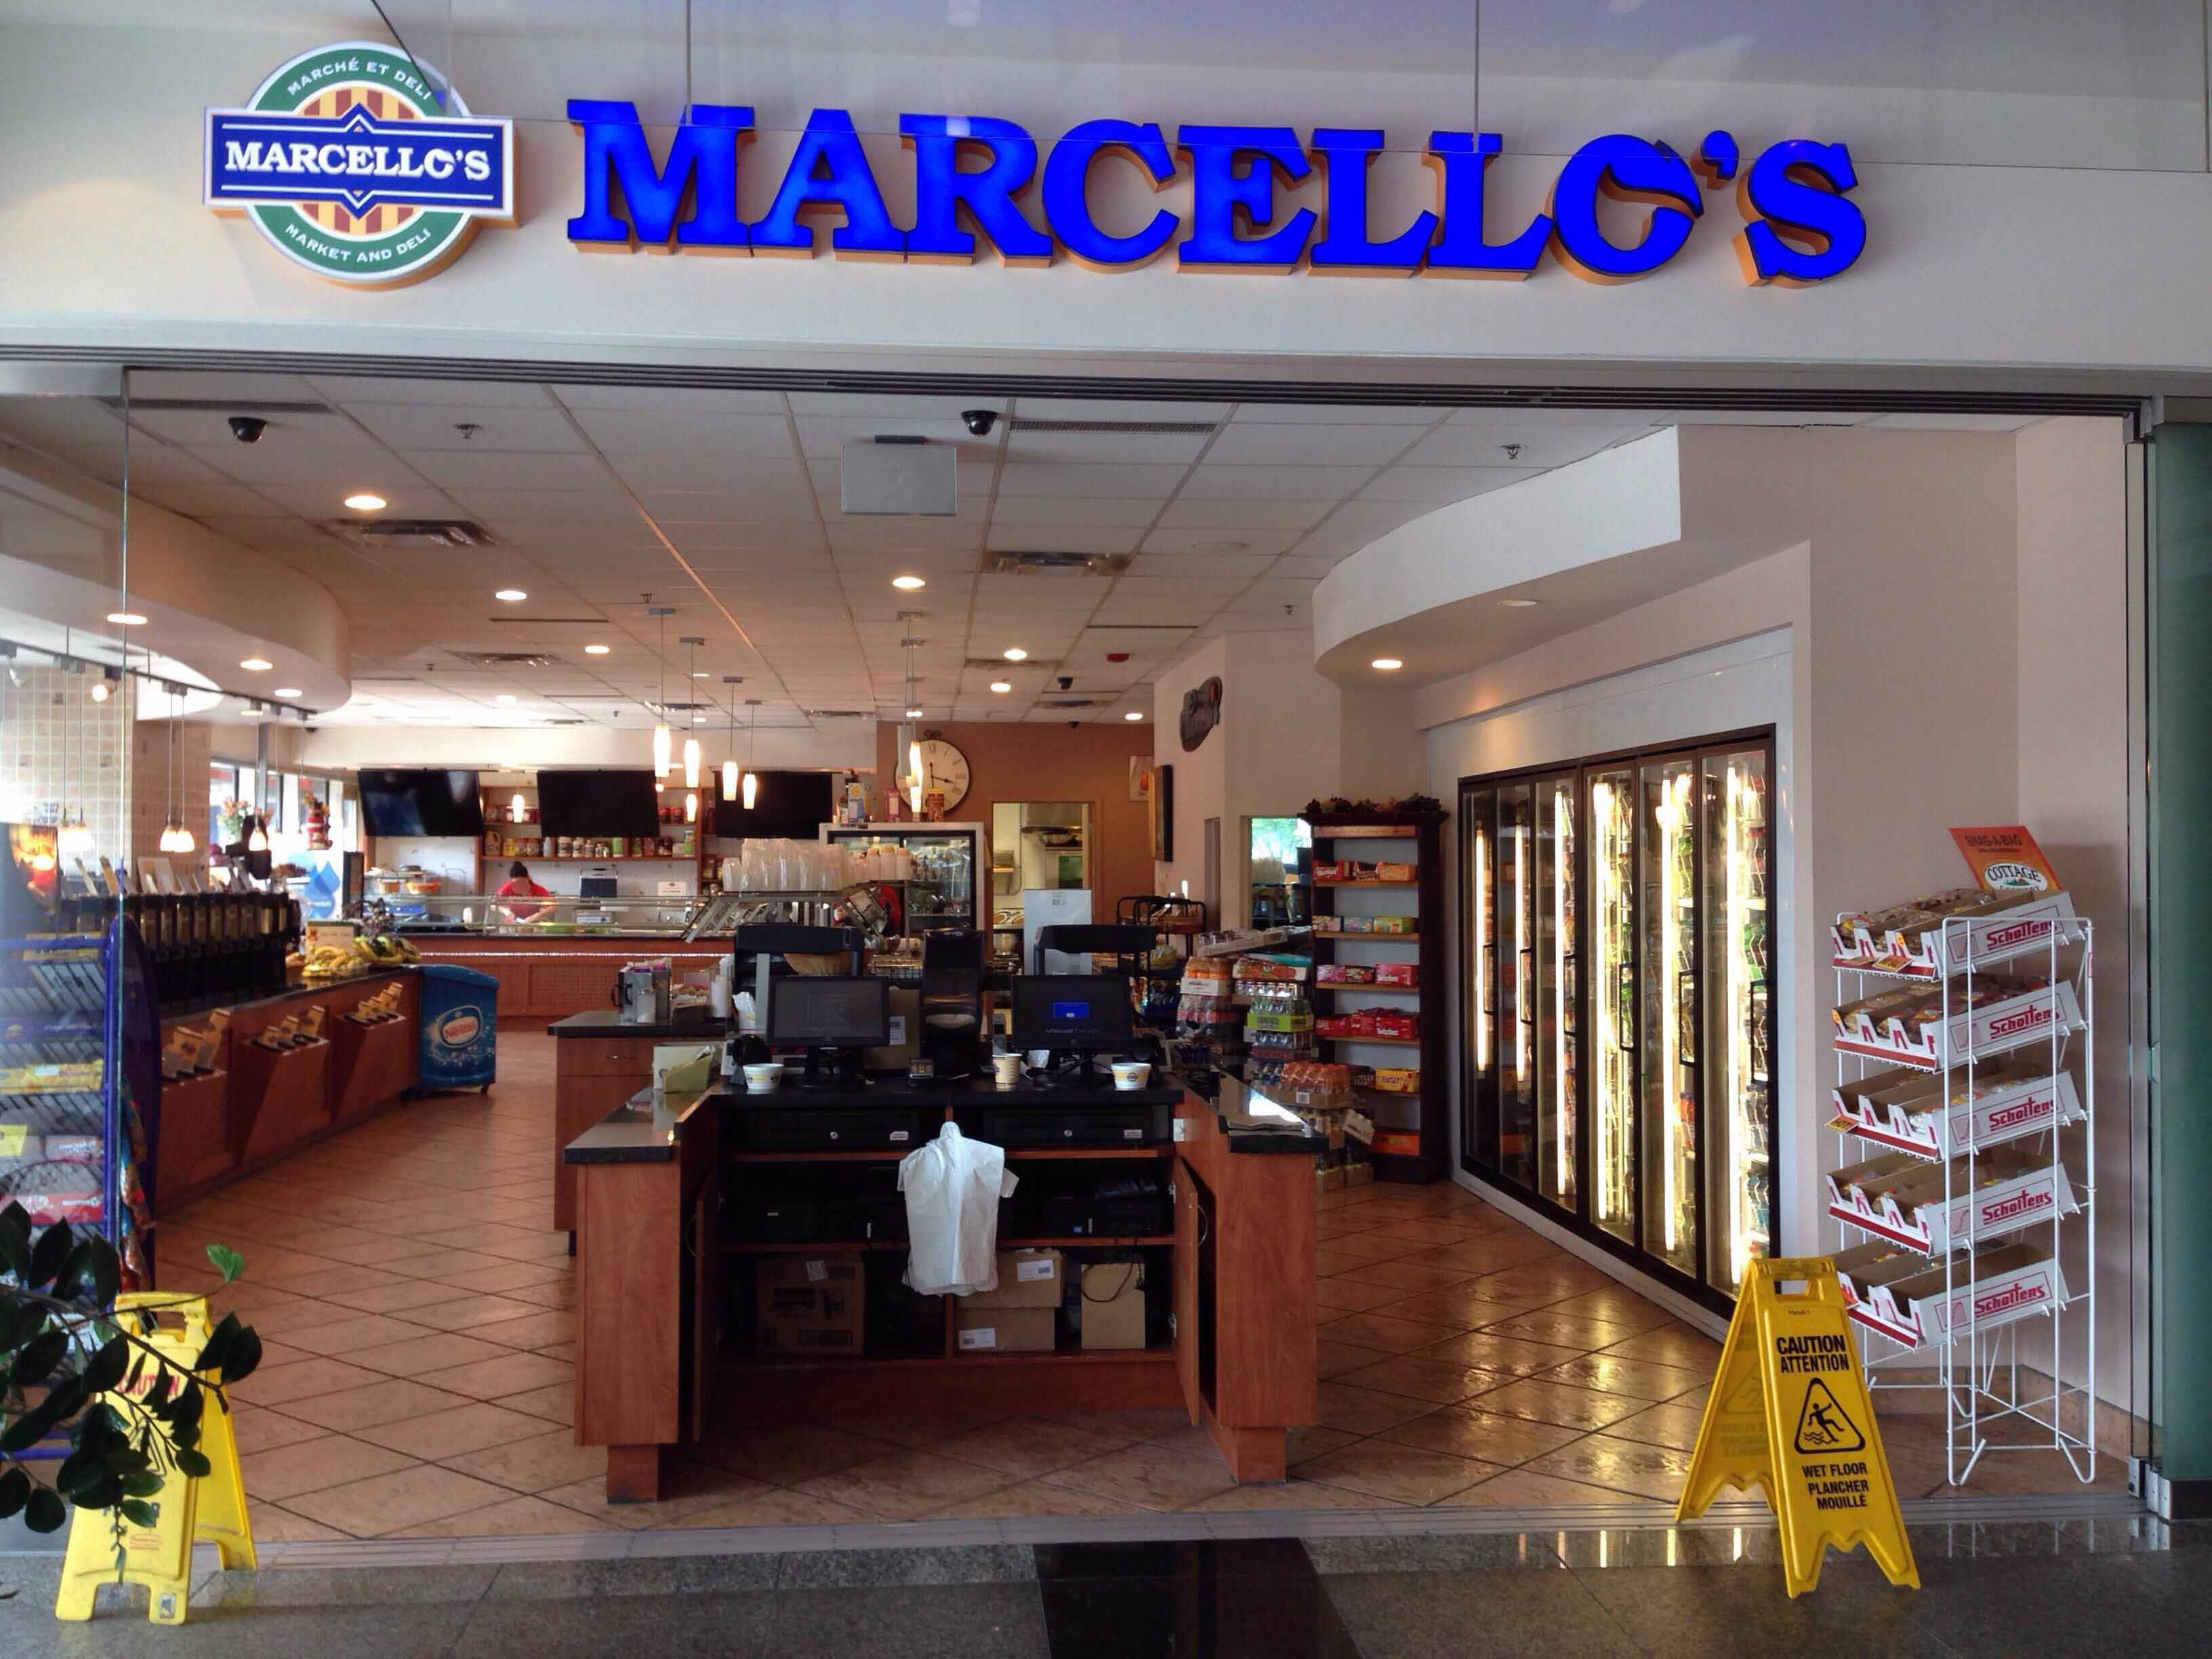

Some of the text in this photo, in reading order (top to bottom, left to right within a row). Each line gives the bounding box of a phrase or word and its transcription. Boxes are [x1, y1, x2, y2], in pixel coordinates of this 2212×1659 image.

[287, 56, 432, 100] MARCHÉ ET DELI
[225, 141, 490, 181] MARCELLO'S
[567, 100, 1866, 281] MARCELLO'S
[285, 224, 432, 262] MARKET AND DELI
[1987, 865, 2041, 882] COTTAGE
[1982, 1189, 2051, 1223] Scholtens
[1974, 1283, 2045, 1316] Scholtens
[1776, 1334, 1846, 1355] CAUTION
[1780, 1353, 1849, 1374] ATTENTION
[1802, 1462, 1868, 1478] WET FLOOR
[1808, 1479, 1869, 1496] PLANCHER
[1817, 1494, 1868, 1510] MOUILLÉ
